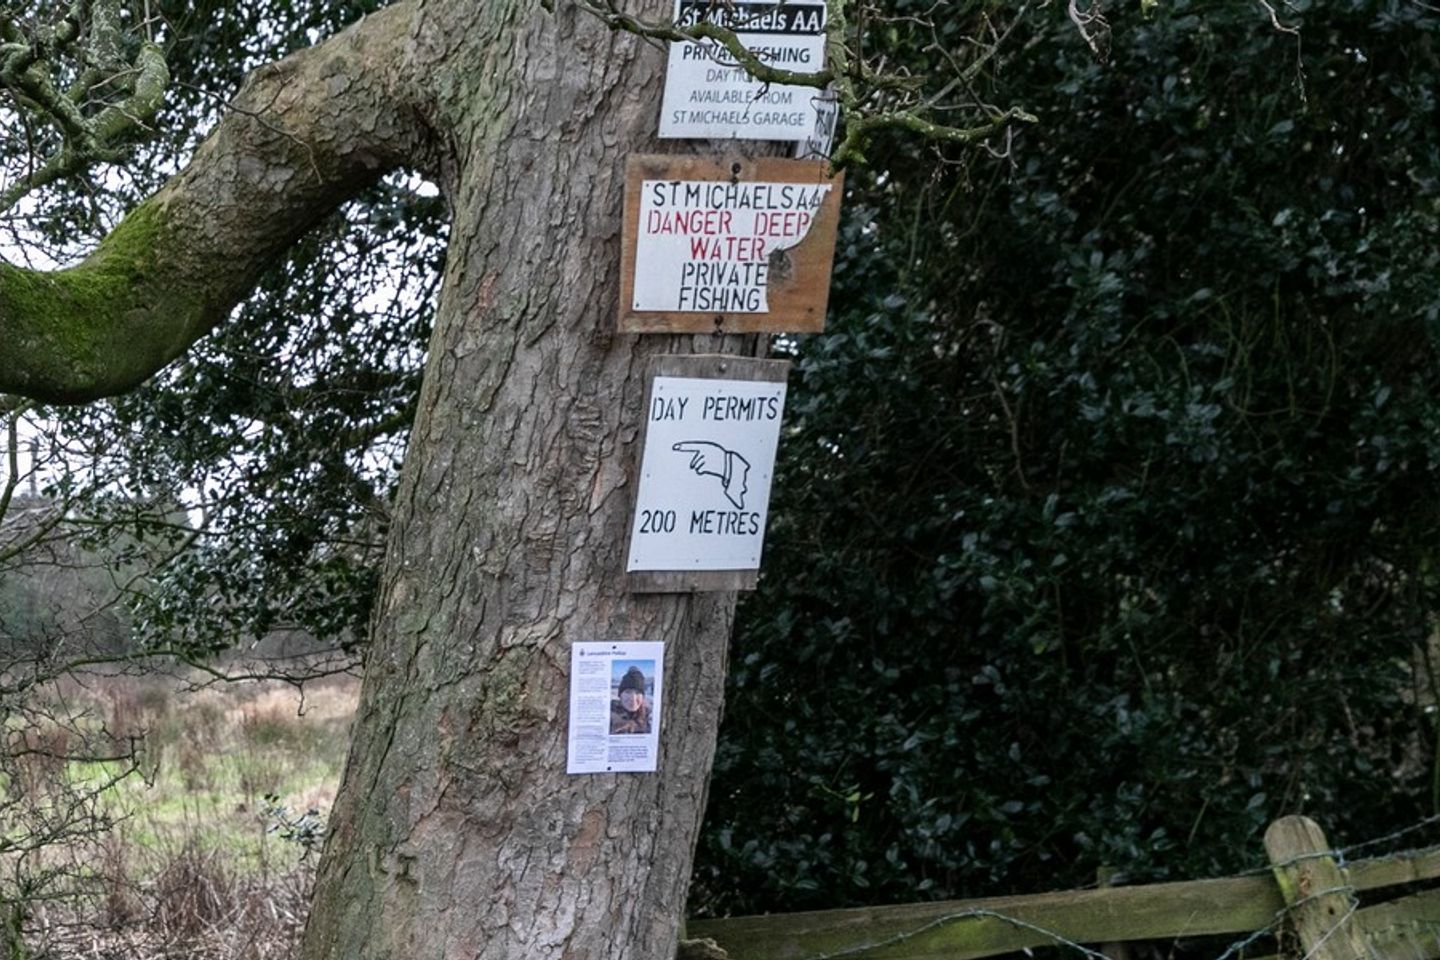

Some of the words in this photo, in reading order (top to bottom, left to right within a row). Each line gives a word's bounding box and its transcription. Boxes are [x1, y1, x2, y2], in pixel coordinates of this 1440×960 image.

[791, 12, 820, 31] AA
[706, 68, 730, 83] DAY
[690, 90, 752, 105] AVAILABLE
[672, 110, 688, 124] ST
[689, 110, 750, 125] MICHAELS
[752, 112, 806, 126] GARAGE
[647, 210, 732, 235] DANGER
[754, 212, 810, 237] DEEP
[690, 236, 767, 262] WATER
[681, 262, 768, 287] PRIVATE
[678, 287, 761, 312] FISHING
[651, 397, 689, 422] DAY
[702, 396, 779, 422] PERMITS
[639, 510, 677, 534] 200
[689, 510, 761, 535] METRES
